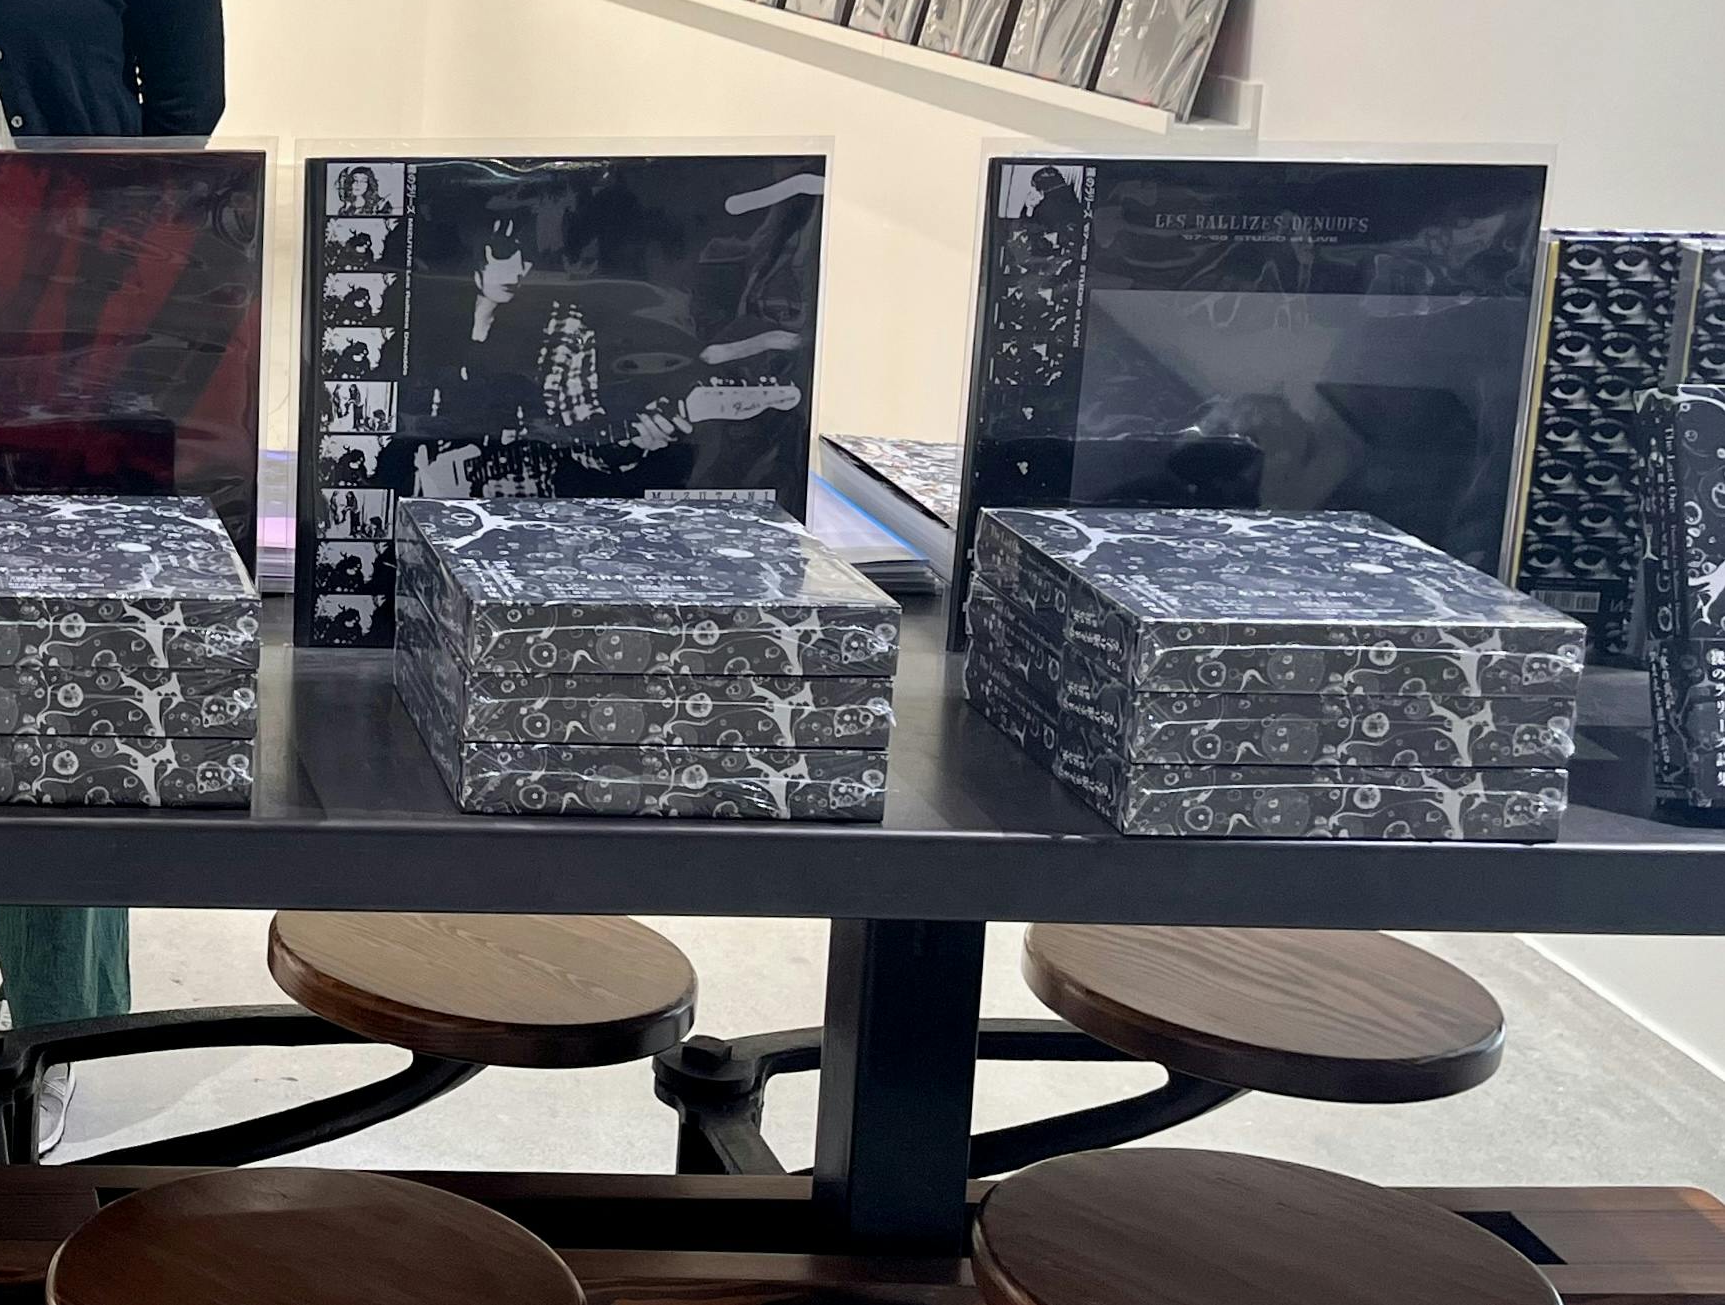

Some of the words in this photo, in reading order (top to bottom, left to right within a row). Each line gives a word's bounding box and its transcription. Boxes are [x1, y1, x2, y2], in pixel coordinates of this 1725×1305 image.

[1155, 214, 1186, 228] LES
[1196, 215, 1283, 231] RALLIZES
[1076, 265, 1086, 307] STUDIO
[1072, 323, 1080, 348] LIVE
